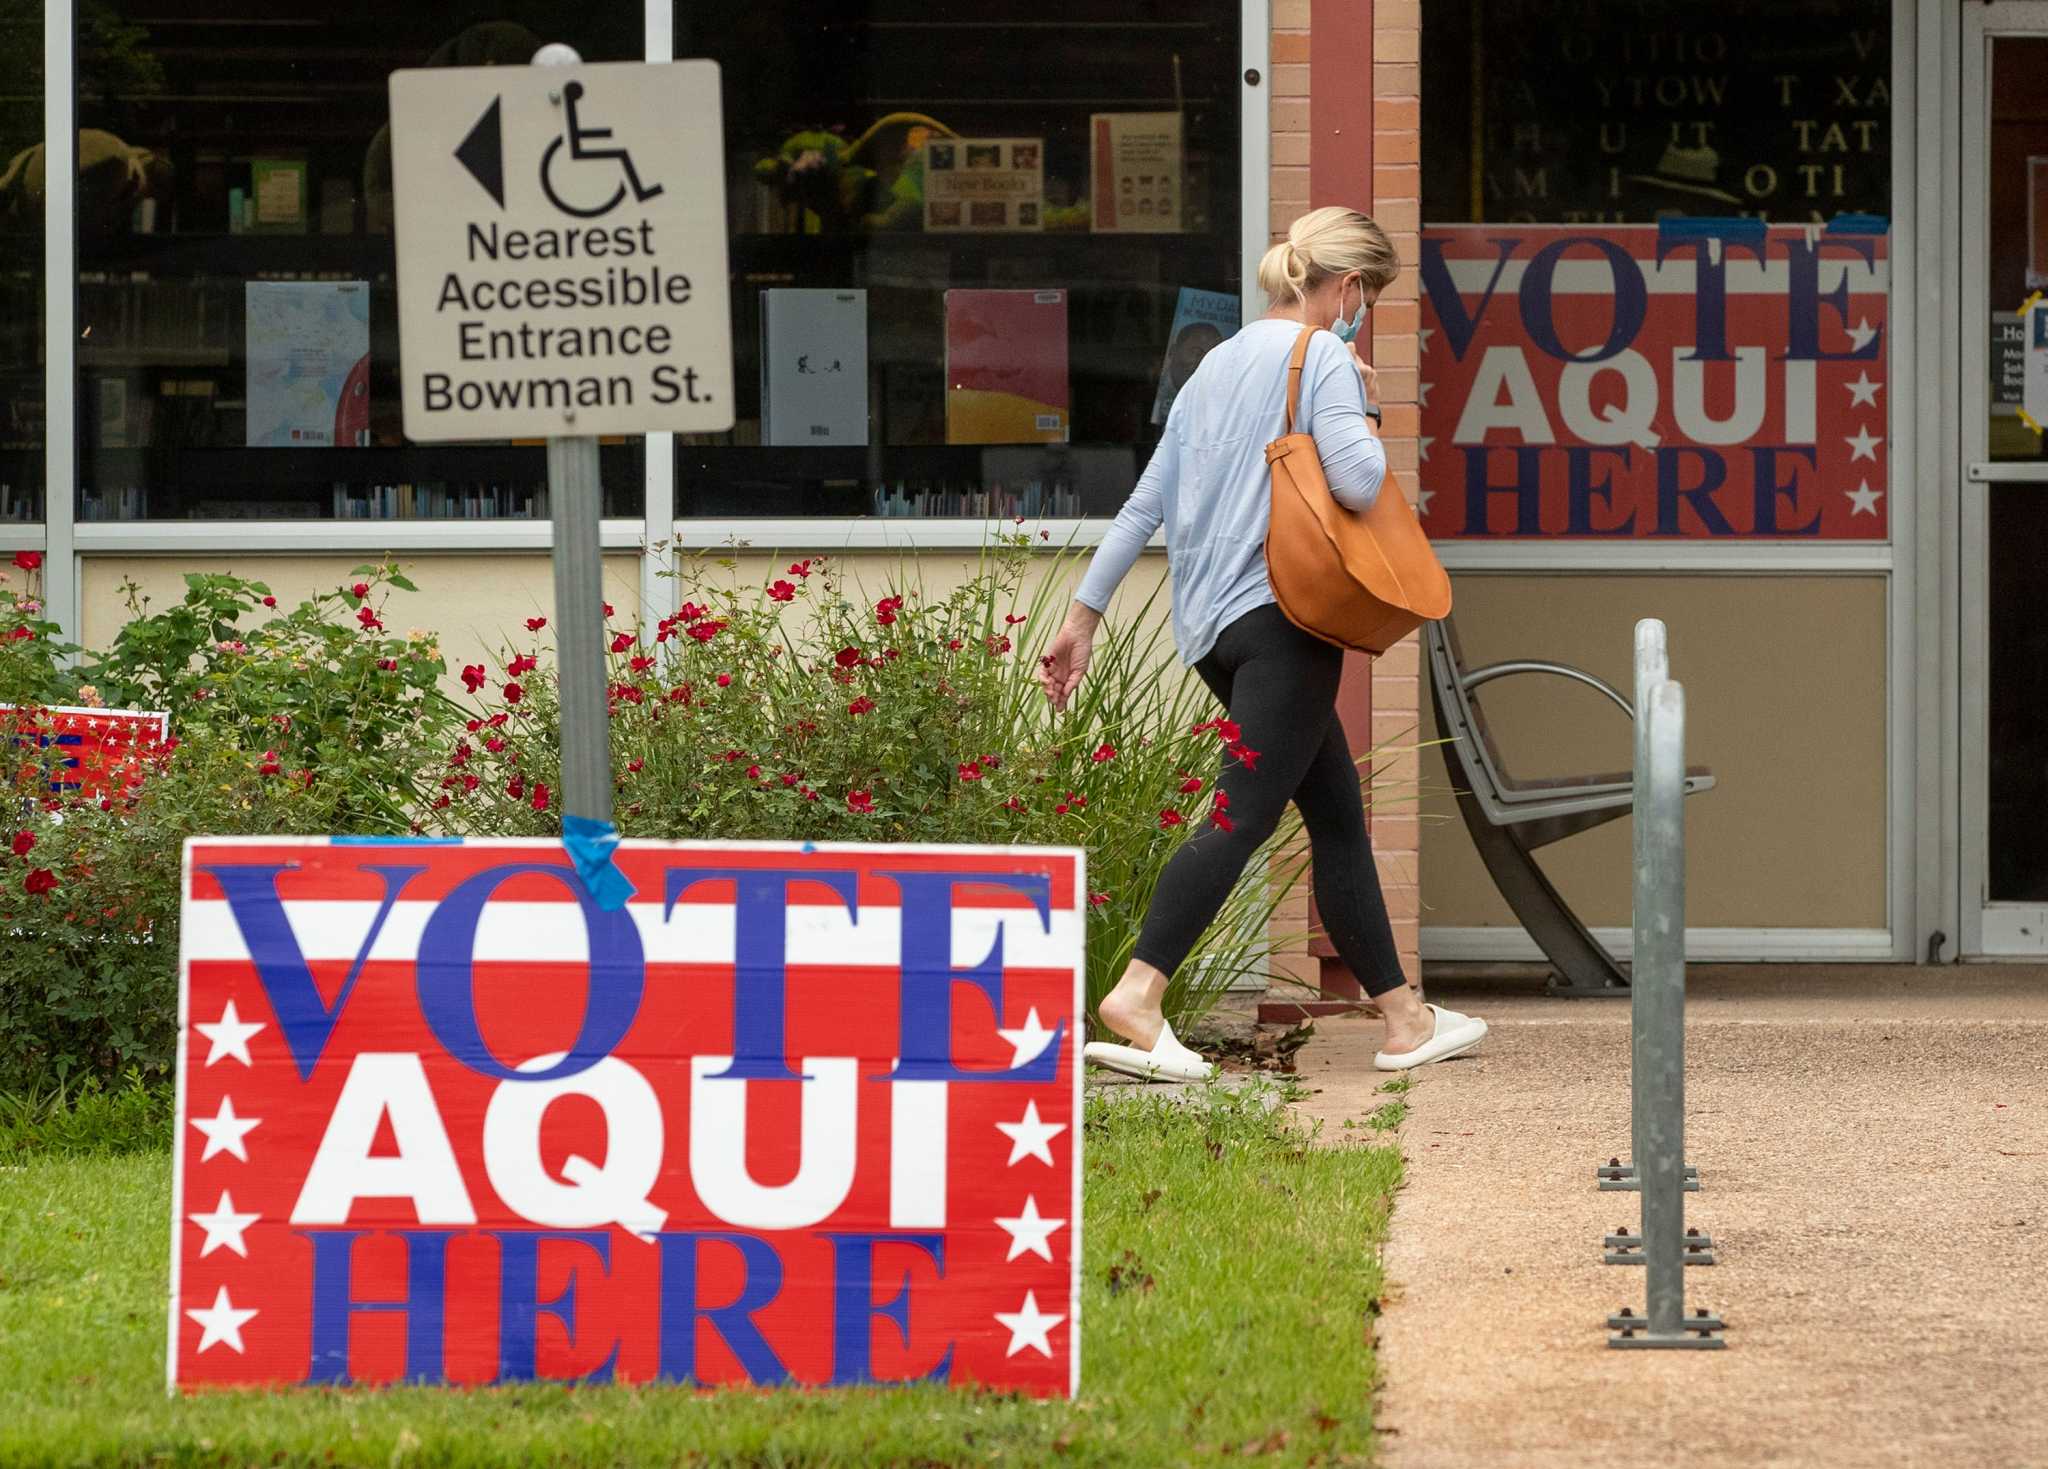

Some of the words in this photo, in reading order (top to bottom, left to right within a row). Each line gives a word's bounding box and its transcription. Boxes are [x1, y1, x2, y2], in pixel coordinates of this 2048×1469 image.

[437, 266, 692, 312] Accessible
[467, 219, 655, 261] Nearest
[459, 321, 671, 361] Entrance
[1420, 236, 1884, 363] VOTE
[423, 373, 633, 411] Bowman
[650, 364, 713, 404] St.
[1452, 345, 1818, 454] AQUI
[1455, 445, 1824, 538] HERE
[201, 863, 1066, 1082] VOTE
[289, 1052, 949, 1245] AQUI
[296, 1230, 955, 1389] HERE
